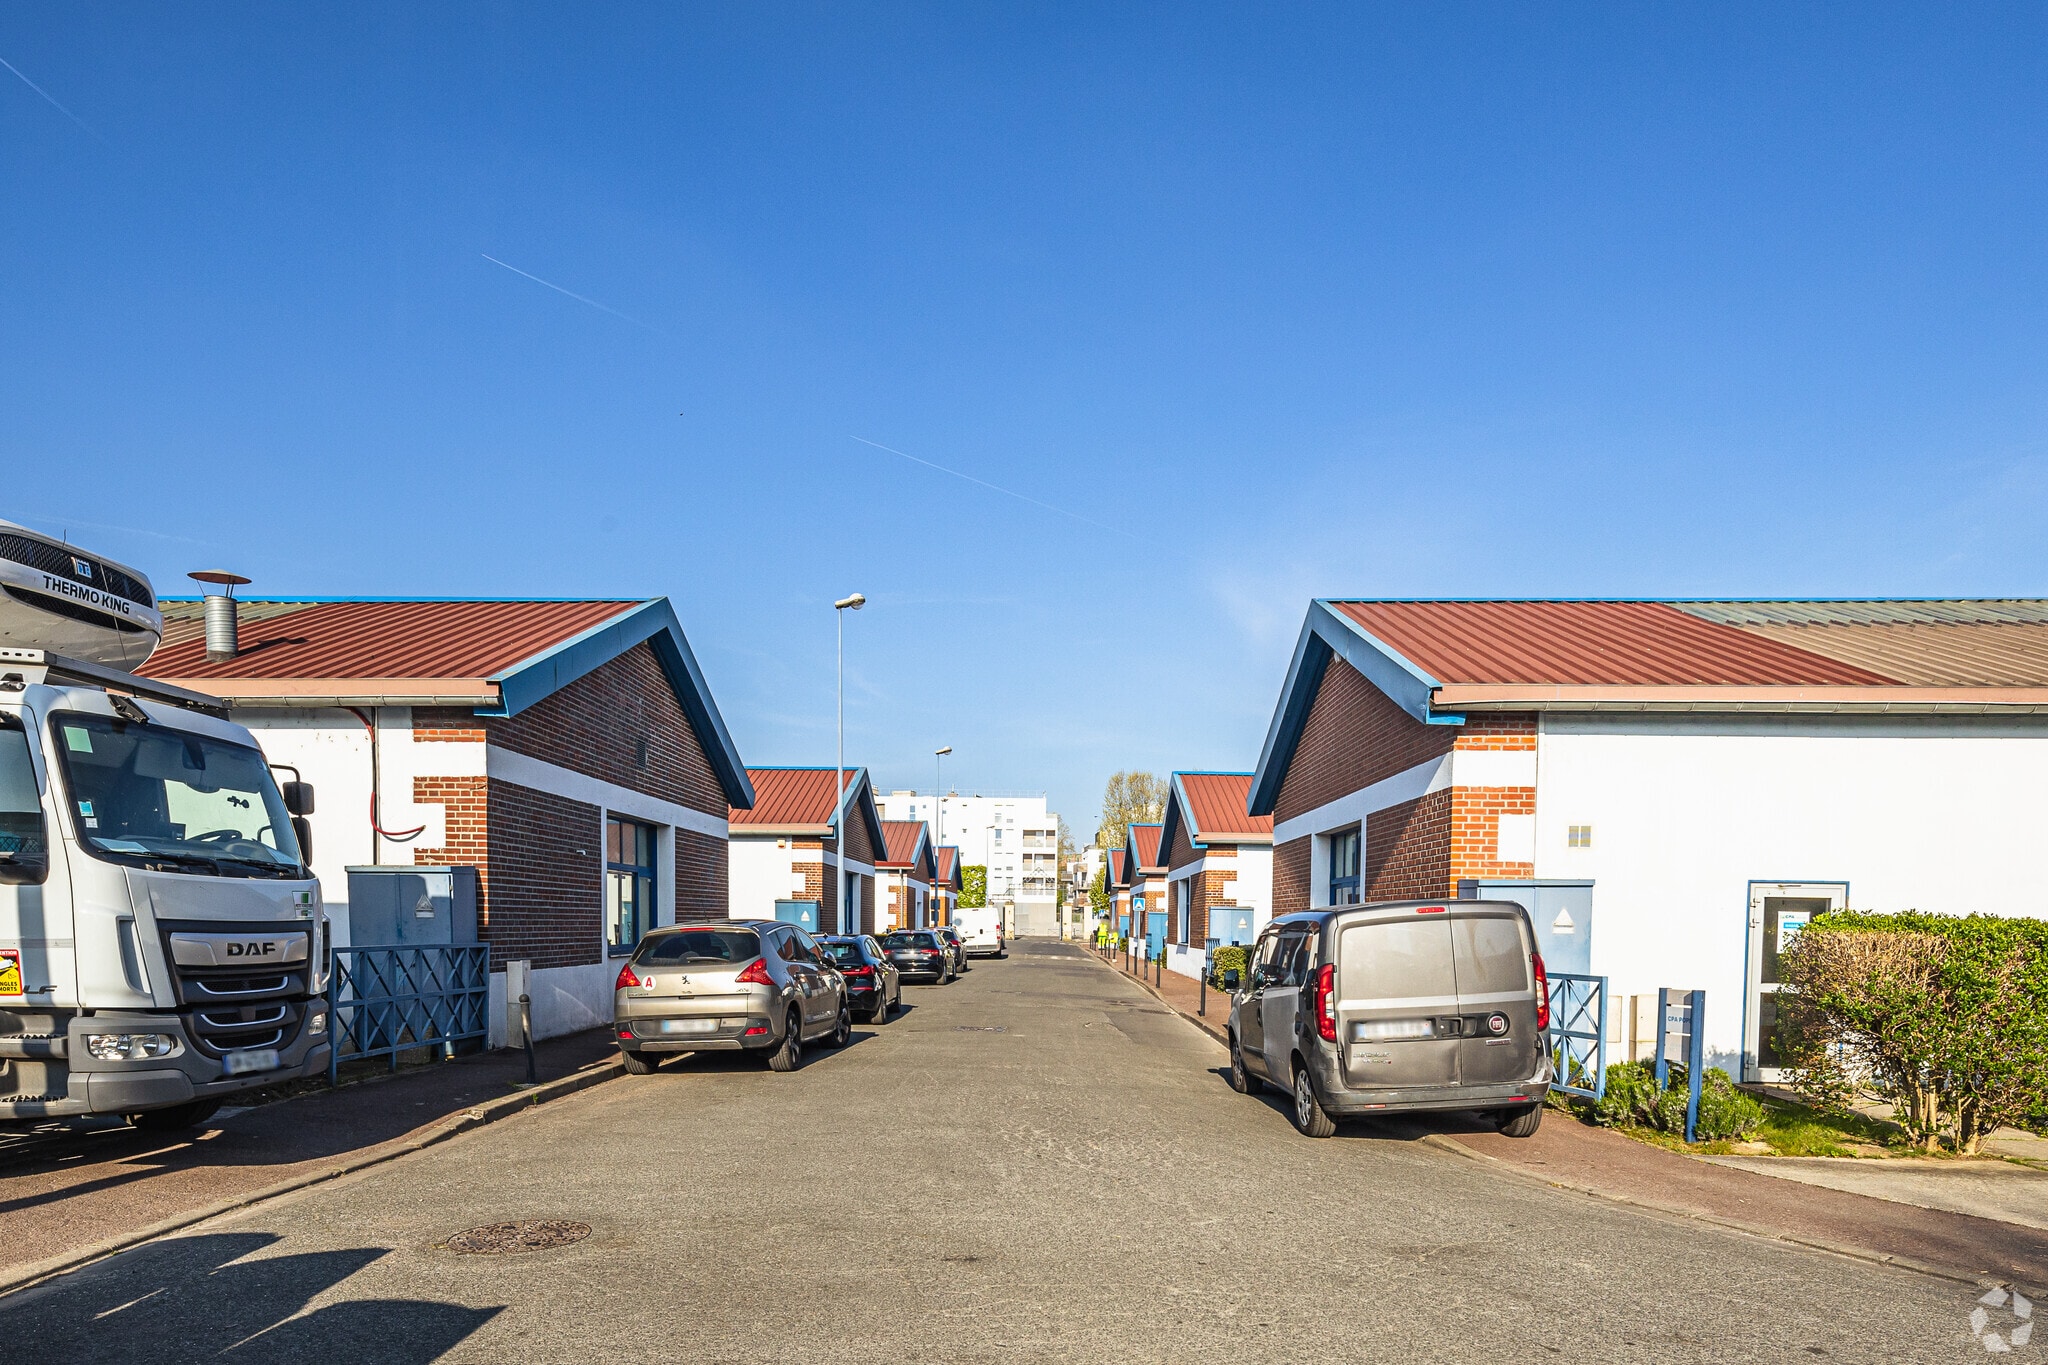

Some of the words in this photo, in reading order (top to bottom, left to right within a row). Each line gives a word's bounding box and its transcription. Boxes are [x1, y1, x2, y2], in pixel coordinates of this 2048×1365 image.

[43, 575, 99, 603] THERMO
[102, 594, 130, 614] KING
[227, 942, 276, 956] DAF
[645, 977, 653, 988] A
